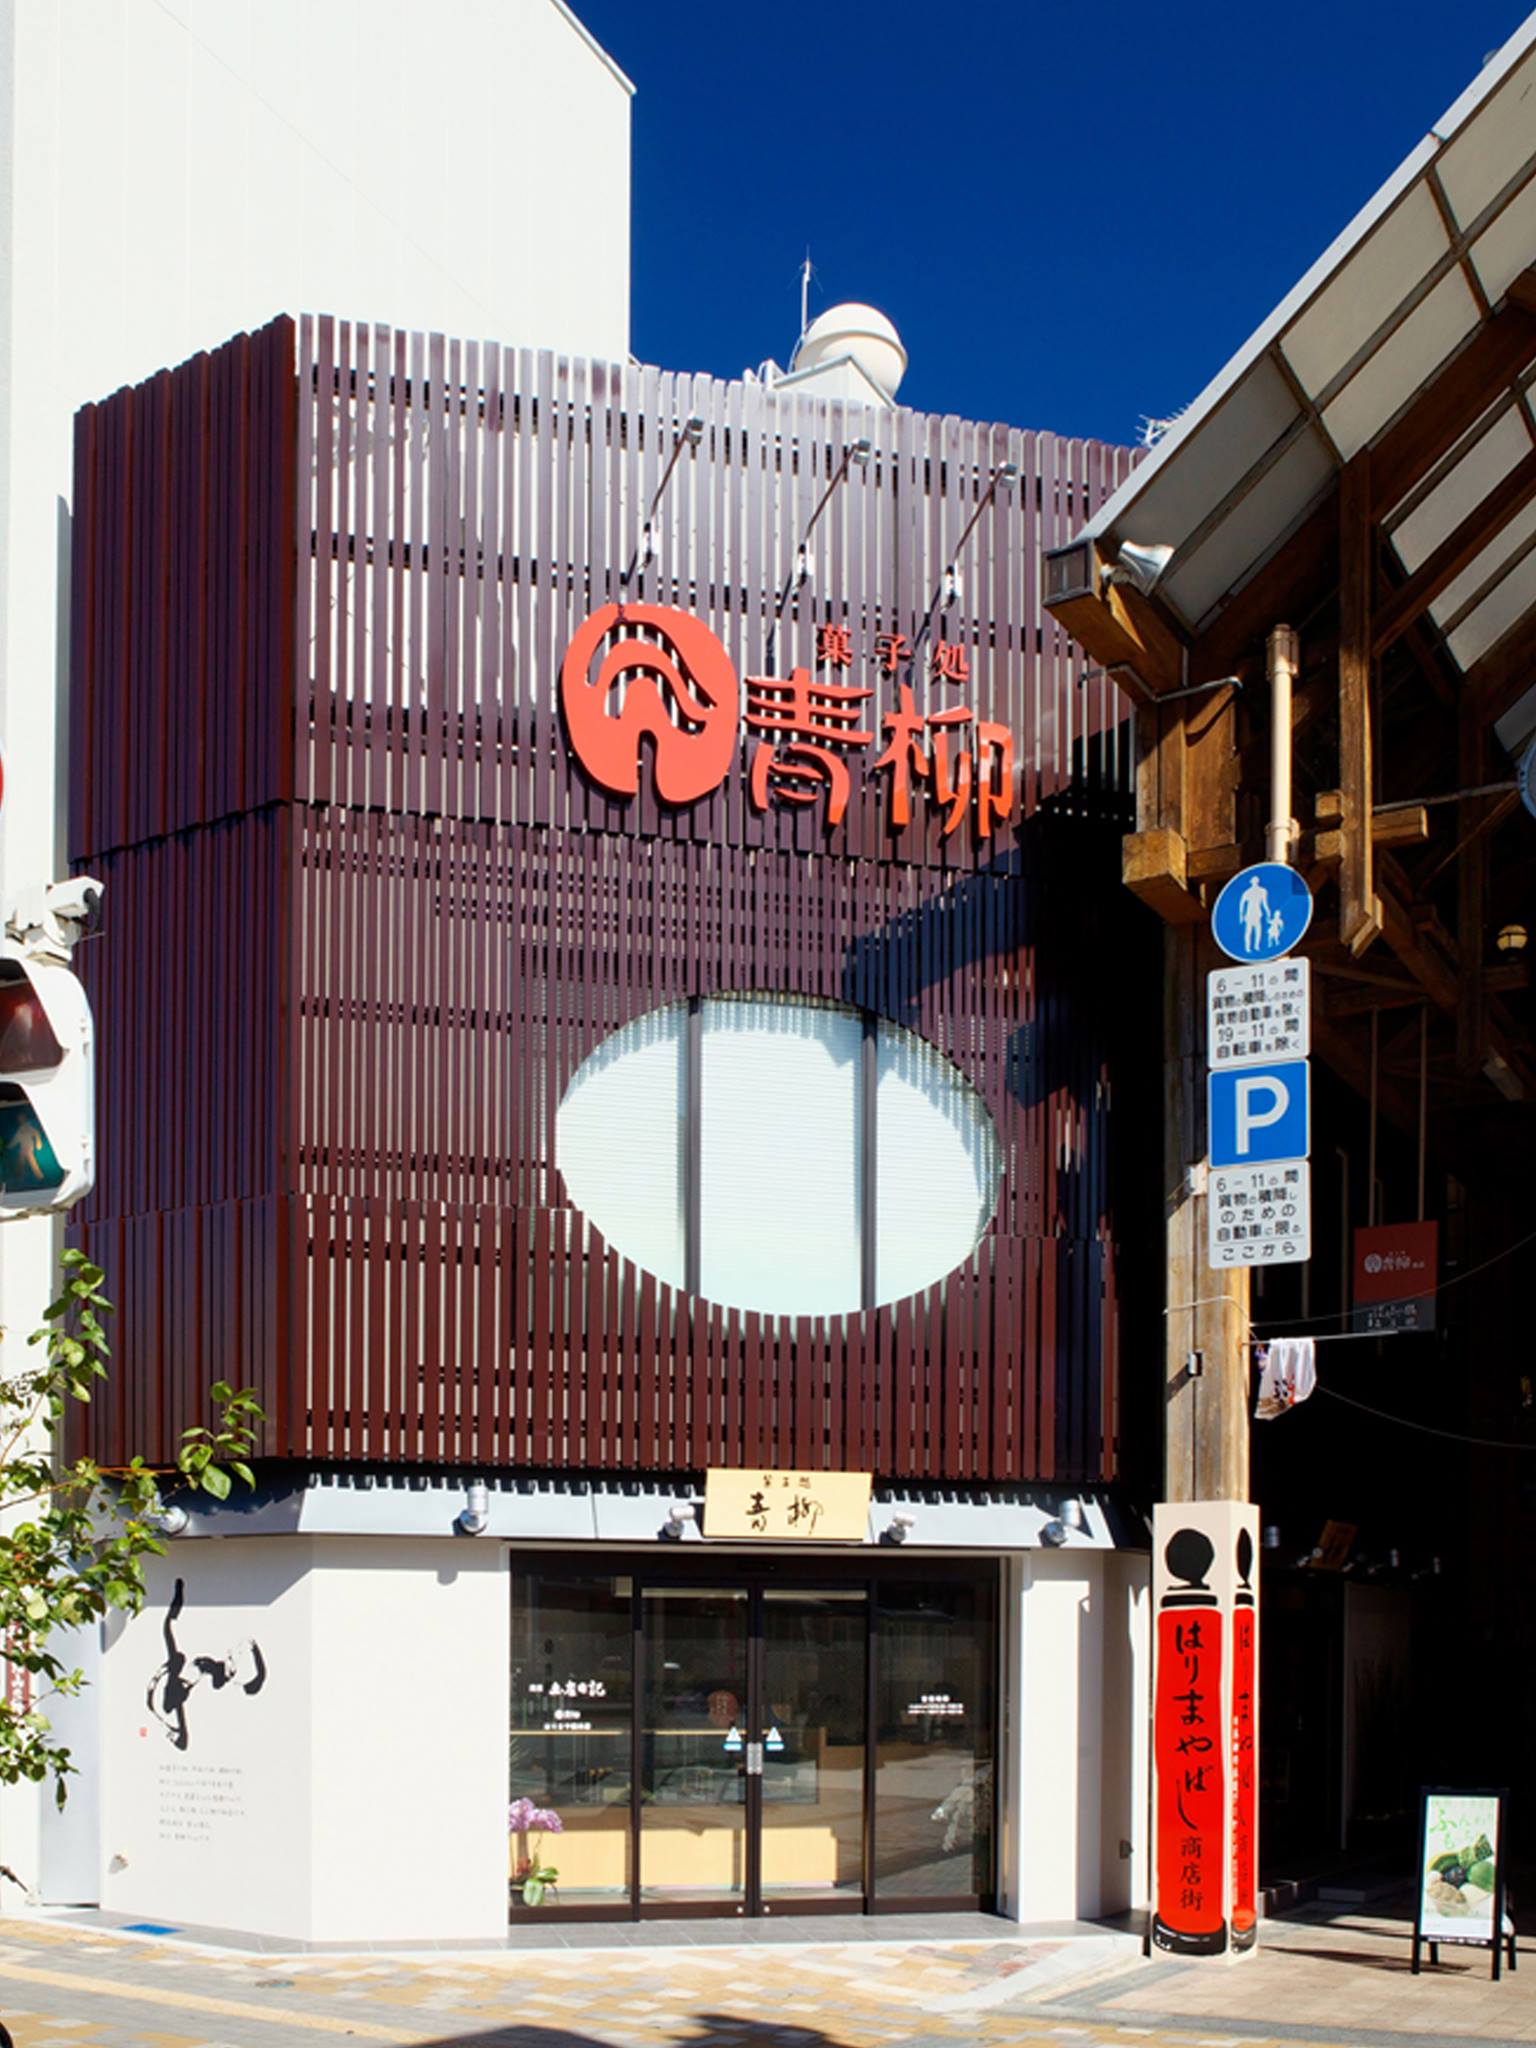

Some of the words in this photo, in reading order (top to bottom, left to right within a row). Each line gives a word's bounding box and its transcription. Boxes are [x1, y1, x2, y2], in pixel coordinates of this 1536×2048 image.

[817, 623, 969, 683] 菓子処
[743, 667, 1013, 838] 青柳
[1235, 1075, 1290, 1155] P
[1222, 1241, 1296, 1261] ここから
[746, 1491, 824, 1535] 青柳
